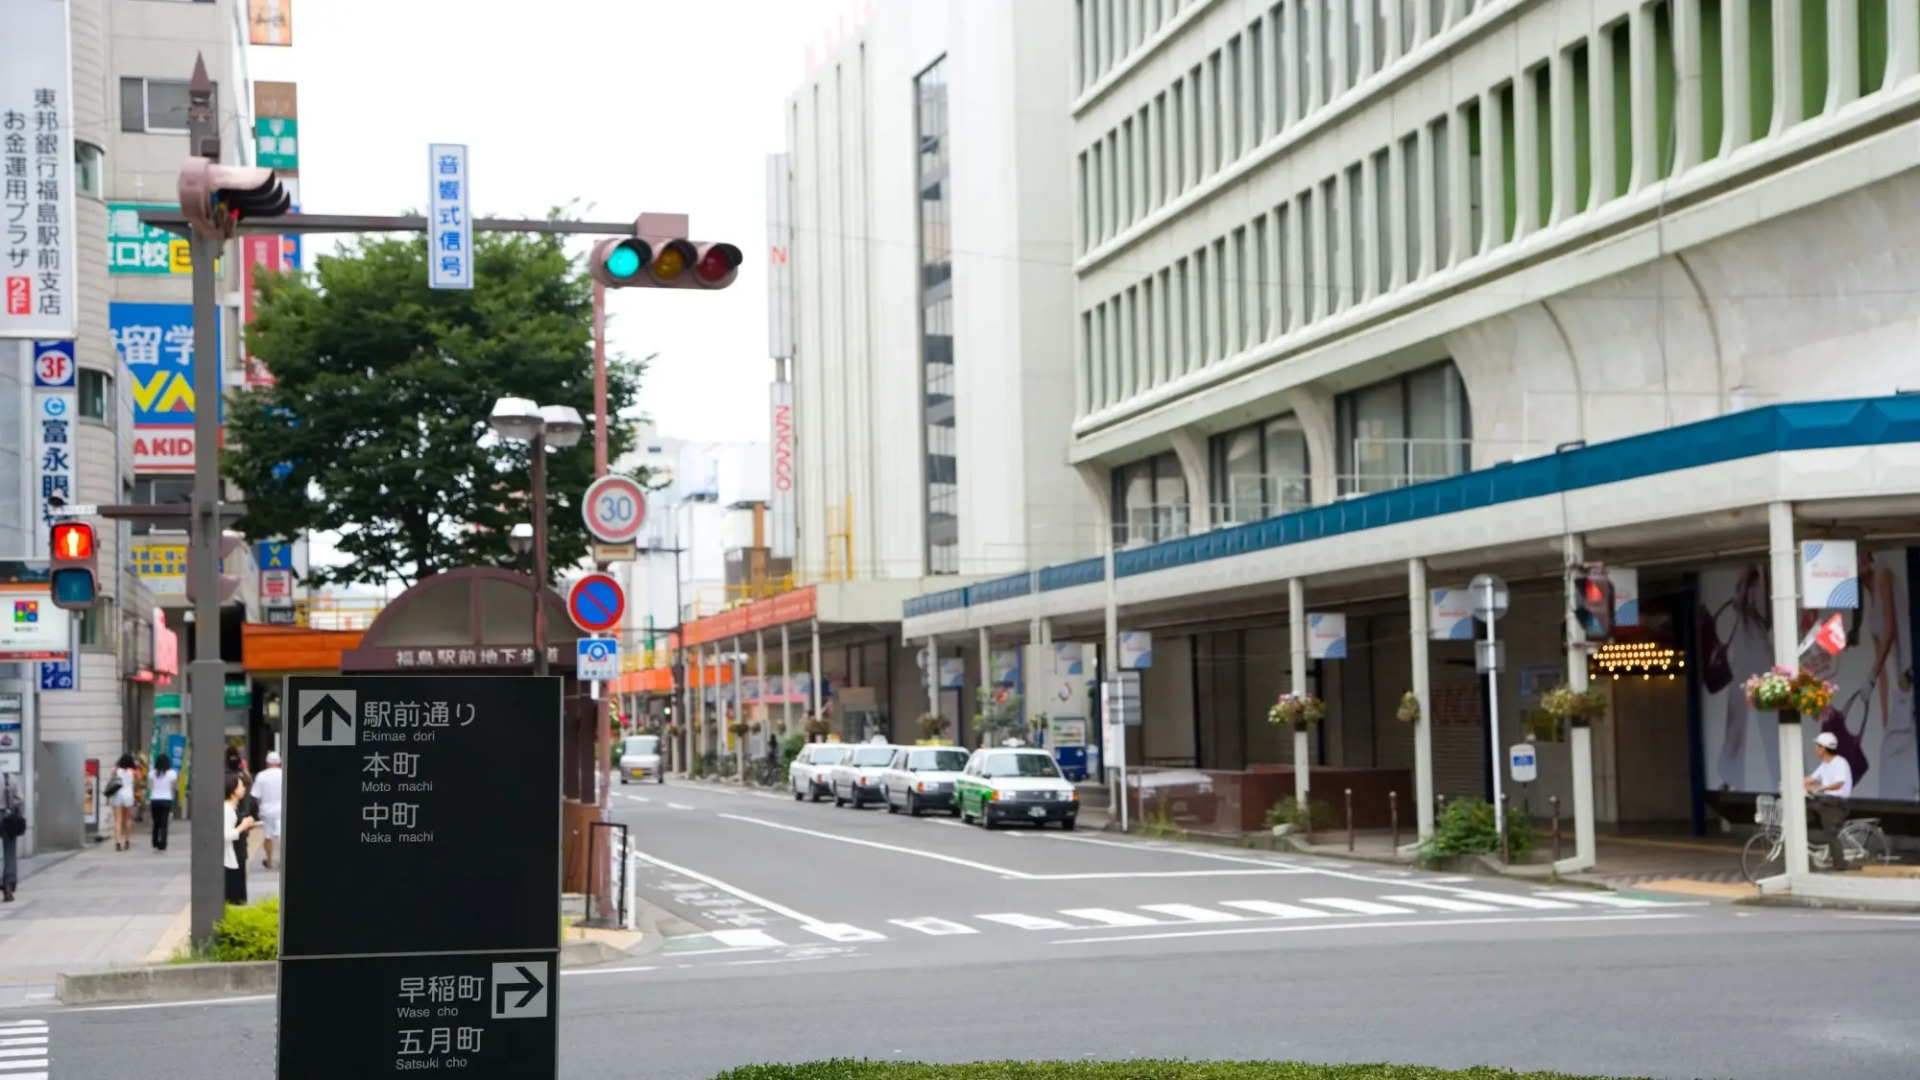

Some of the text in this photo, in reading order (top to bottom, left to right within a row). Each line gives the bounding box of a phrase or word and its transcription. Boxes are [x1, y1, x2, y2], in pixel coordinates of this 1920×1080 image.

[4, 109, 30, 313] お金運用プラザ 2F
[34, 88, 61, 315] 東邦銀行福島駅前支店
[438, 155, 461, 277] 音響式信号
[41, 356, 67, 379] 3F
[600, 496, 632, 522] 30
[364, 701, 476, 728] 駅前通り
[363, 730, 435, 742] Ekimae dori
[362, 752, 420, 778] 本町
[362, 781, 433, 792] Moto machi
[362, 802, 420, 829] 中町
[361, 831, 434, 843] Naka machi
[398, 975, 484, 1003] 早稲町
[397, 1006, 459, 1018] Wase cho
[397, 1027, 484, 1055] 五月町
[396, 1057, 467, 1070] Satsuki cho
